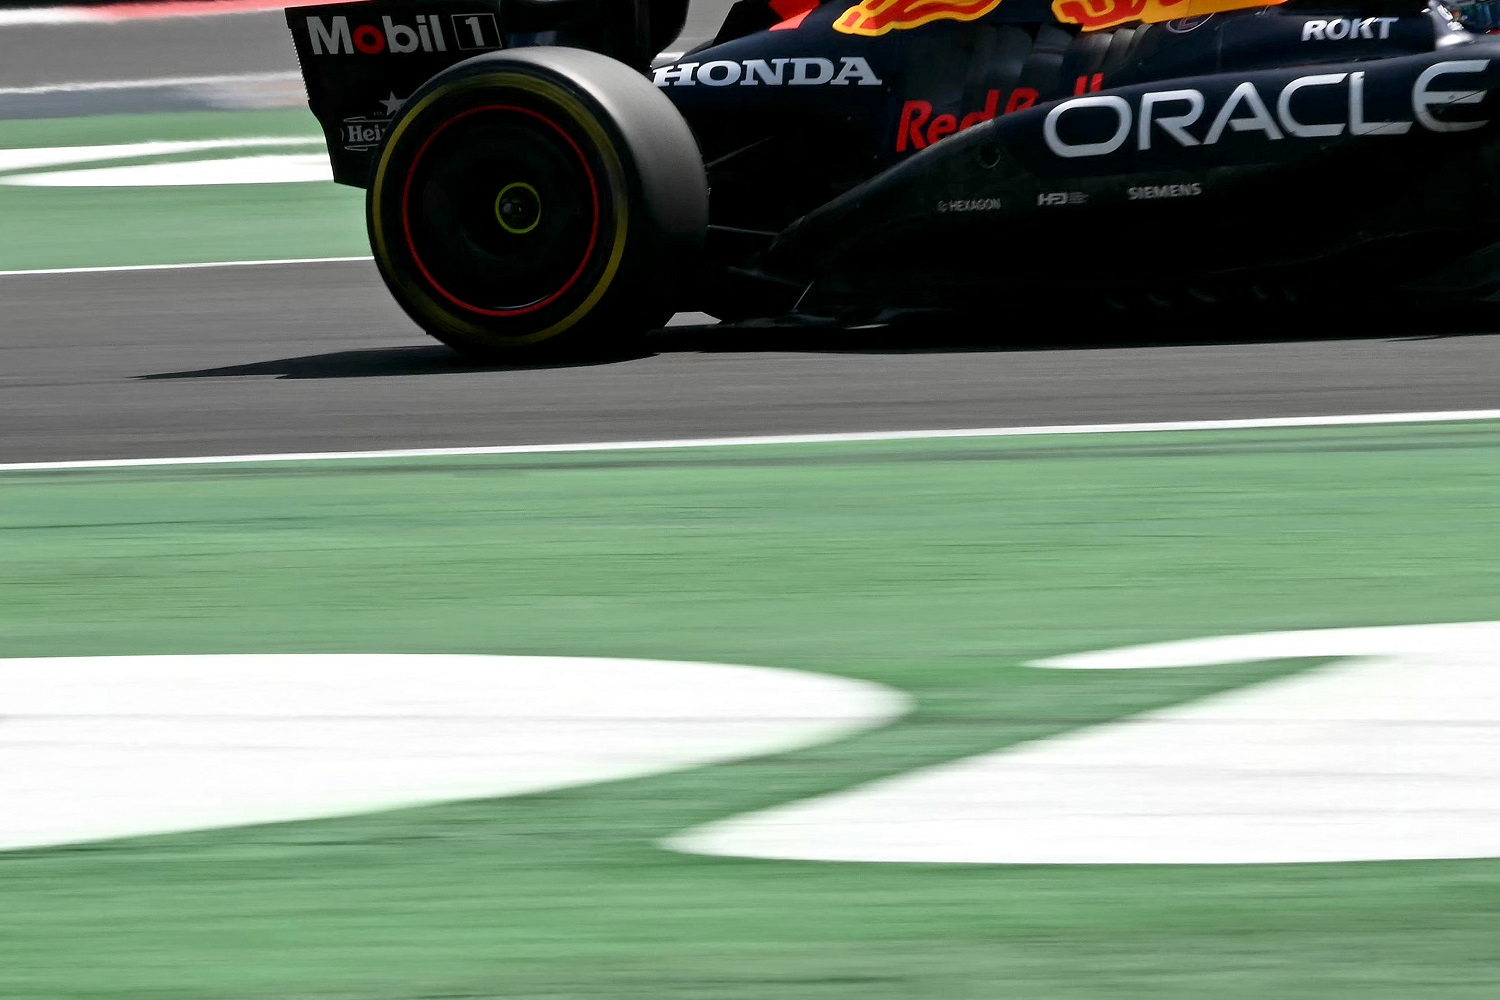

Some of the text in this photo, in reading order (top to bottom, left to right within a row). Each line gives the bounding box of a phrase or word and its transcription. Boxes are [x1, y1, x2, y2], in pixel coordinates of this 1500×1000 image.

[306, 15, 485, 55] Mobil 1
[1302, 16, 1399, 41] ROKT
[652, 57, 882, 87] HONDA
[1043, 59, 1490, 158] ORACLE
[1127, 183, 1202, 200] SIEMENS
